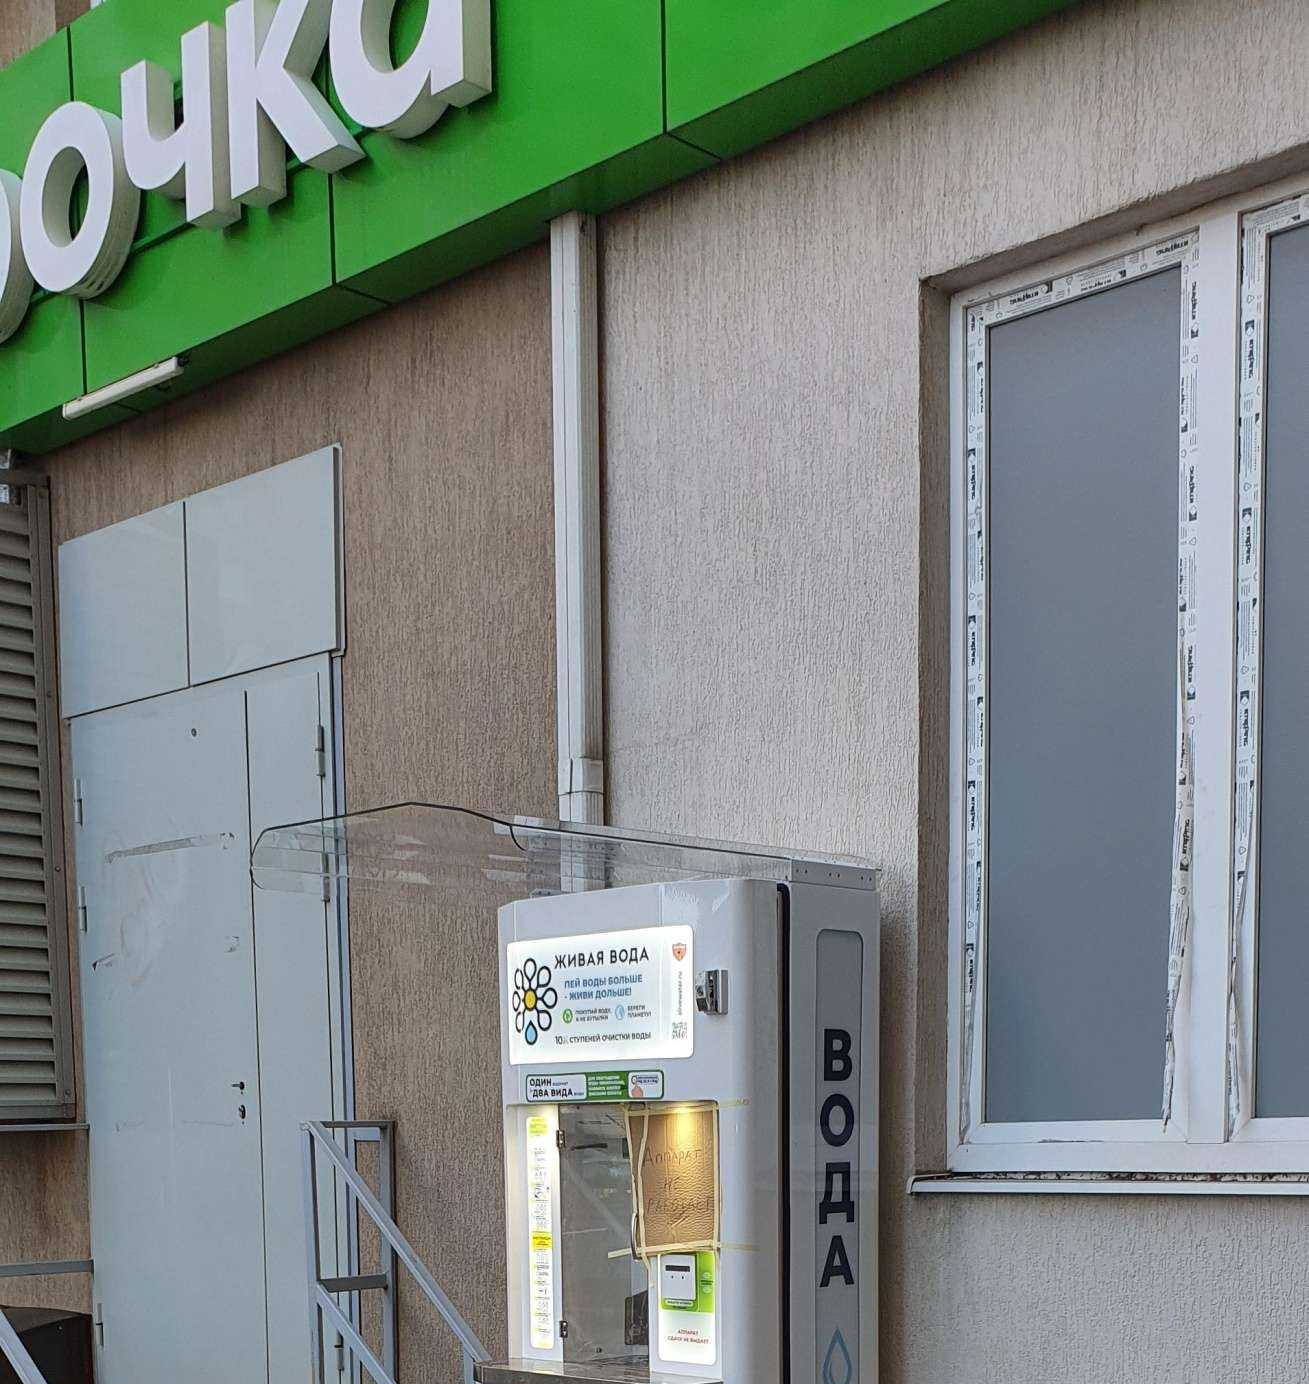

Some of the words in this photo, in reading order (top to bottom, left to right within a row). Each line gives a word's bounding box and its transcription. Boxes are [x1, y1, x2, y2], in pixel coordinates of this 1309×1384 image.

[0, 0, 493, 345] очка
[554, 951, 604, 969] ЖИВАЯ
[610, 946, 649, 964] ВОДА
[564, 978, 580, 989] ПЕЙ
[582, 977, 606, 988] ВОДЫ
[608, 974, 643, 985] БОЛЬШЕ
[569, 991, 594, 1001] ЖИВИ
[595, 987, 632, 1000] ДОЛЬШЕ!
[569, 1034, 600, 1043] СТУПЕНЕЙ
[602, 1033, 630, 1042] ОЧИСТКИ
[632, 1031, 652, 1041] ВОДЫ
[530, 1078, 552, 1088] ОДИН
[533, 1089, 549, 1098] ДВА
[551, 1088, 574, 1098] ВИДА
[819, 1028, 855, 1287] ВОДА
